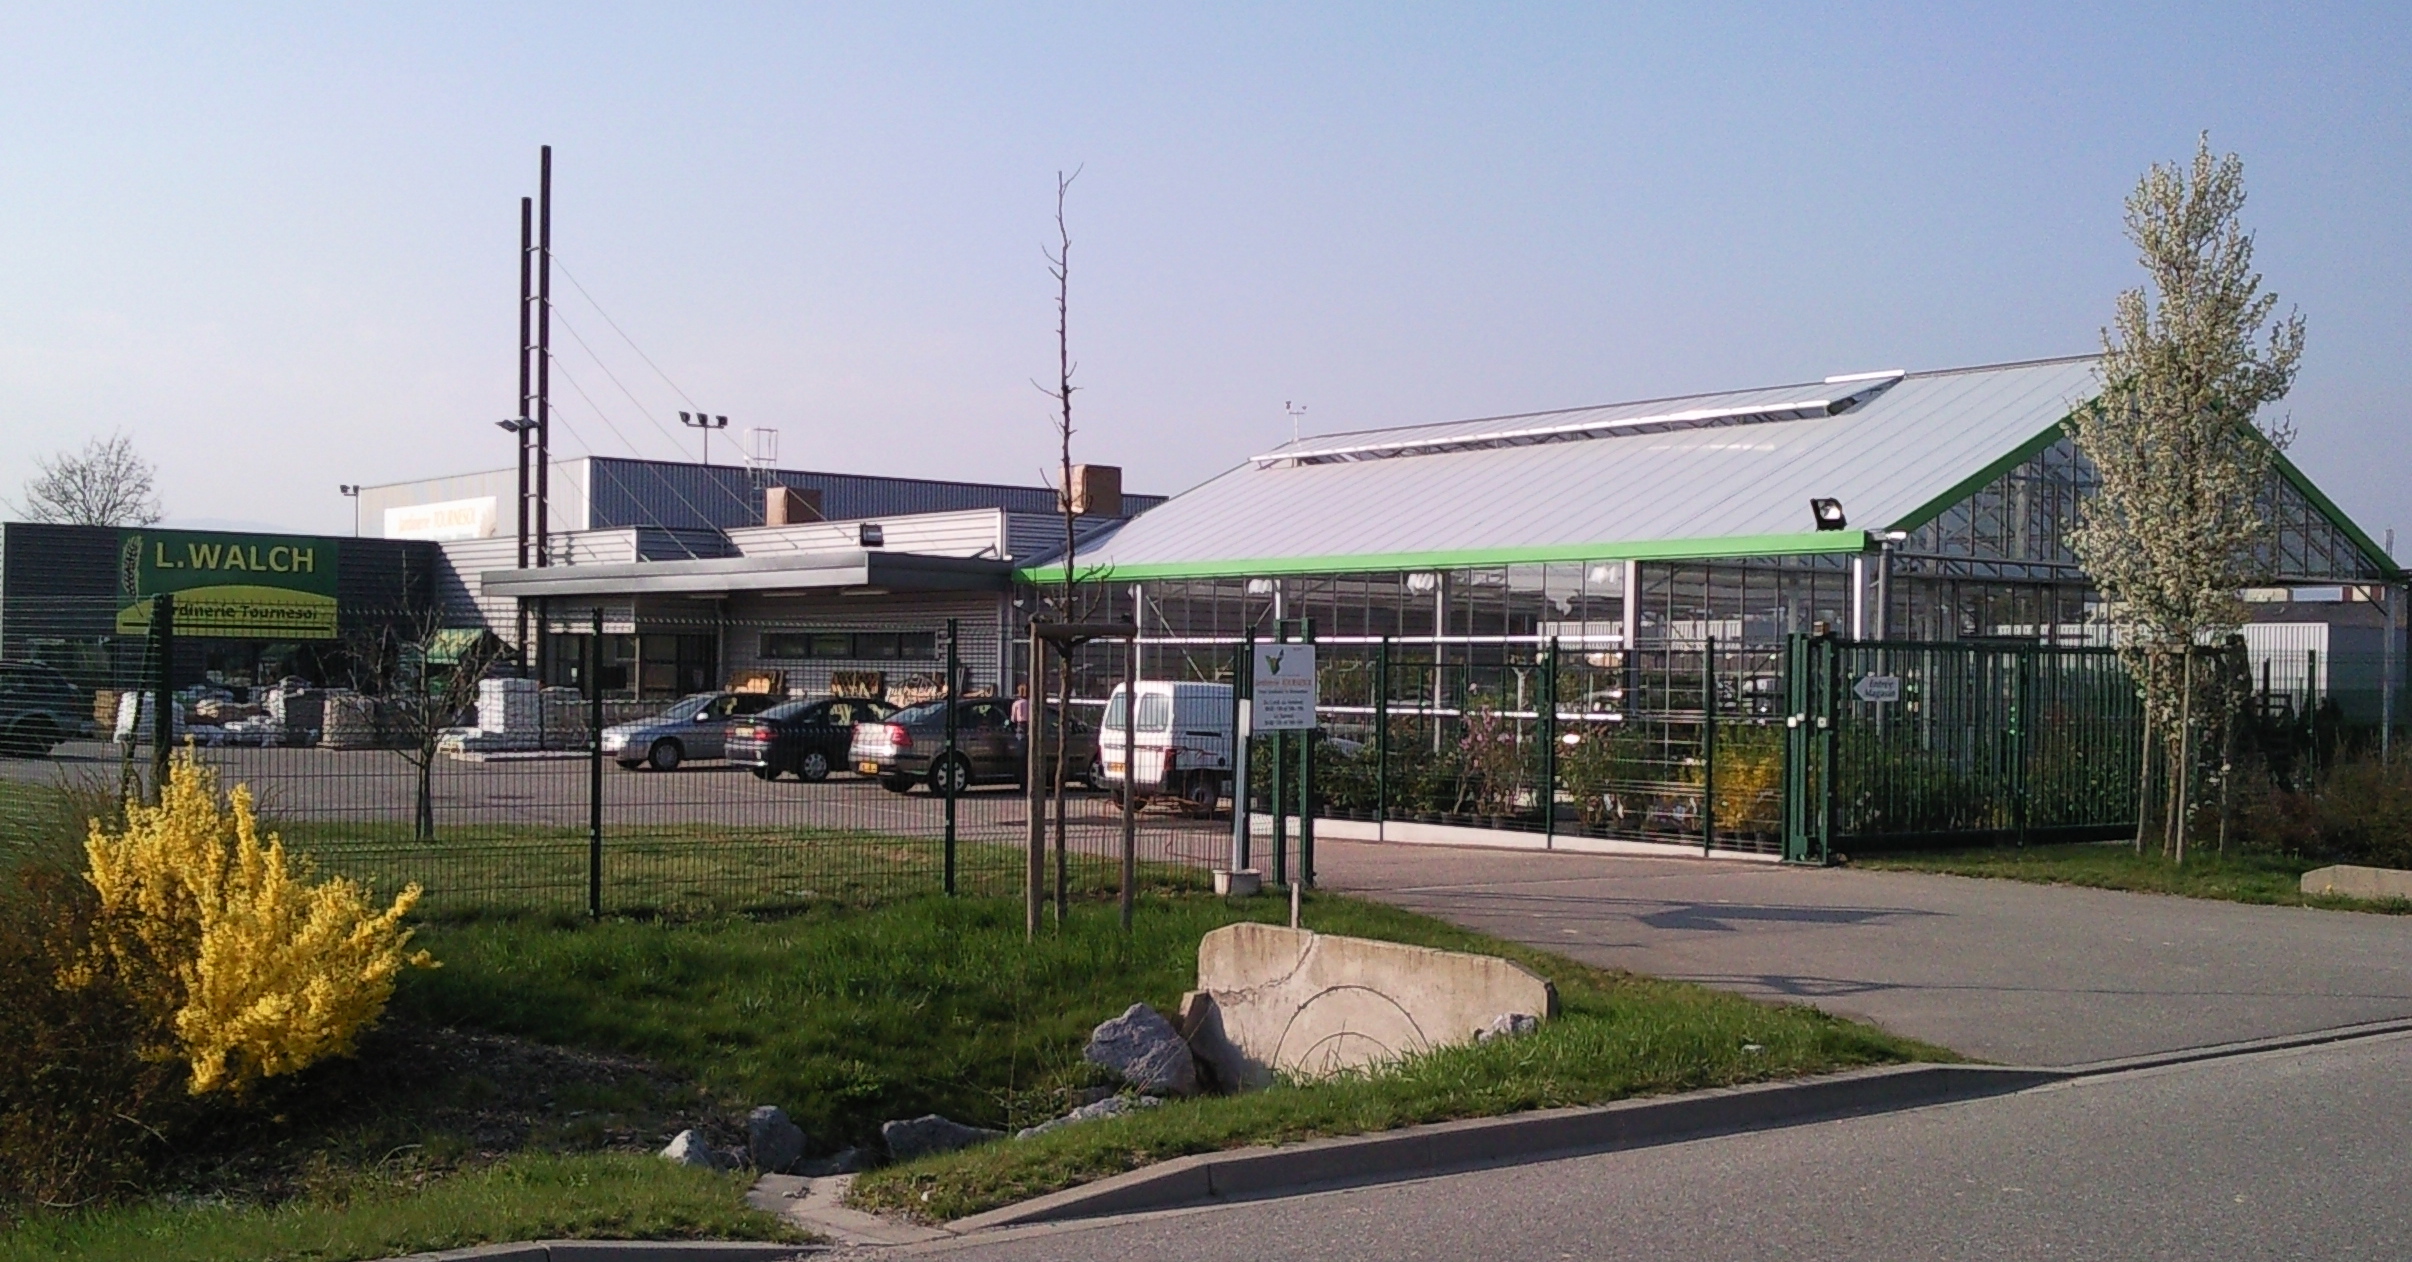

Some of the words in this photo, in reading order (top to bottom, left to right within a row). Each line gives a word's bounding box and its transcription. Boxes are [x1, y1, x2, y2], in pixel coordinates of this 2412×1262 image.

[156, 541, 314, 574] L.WALCH
[172, 603, 236, 618] rdinerie
[241, 605, 317, 620] Tournesol
